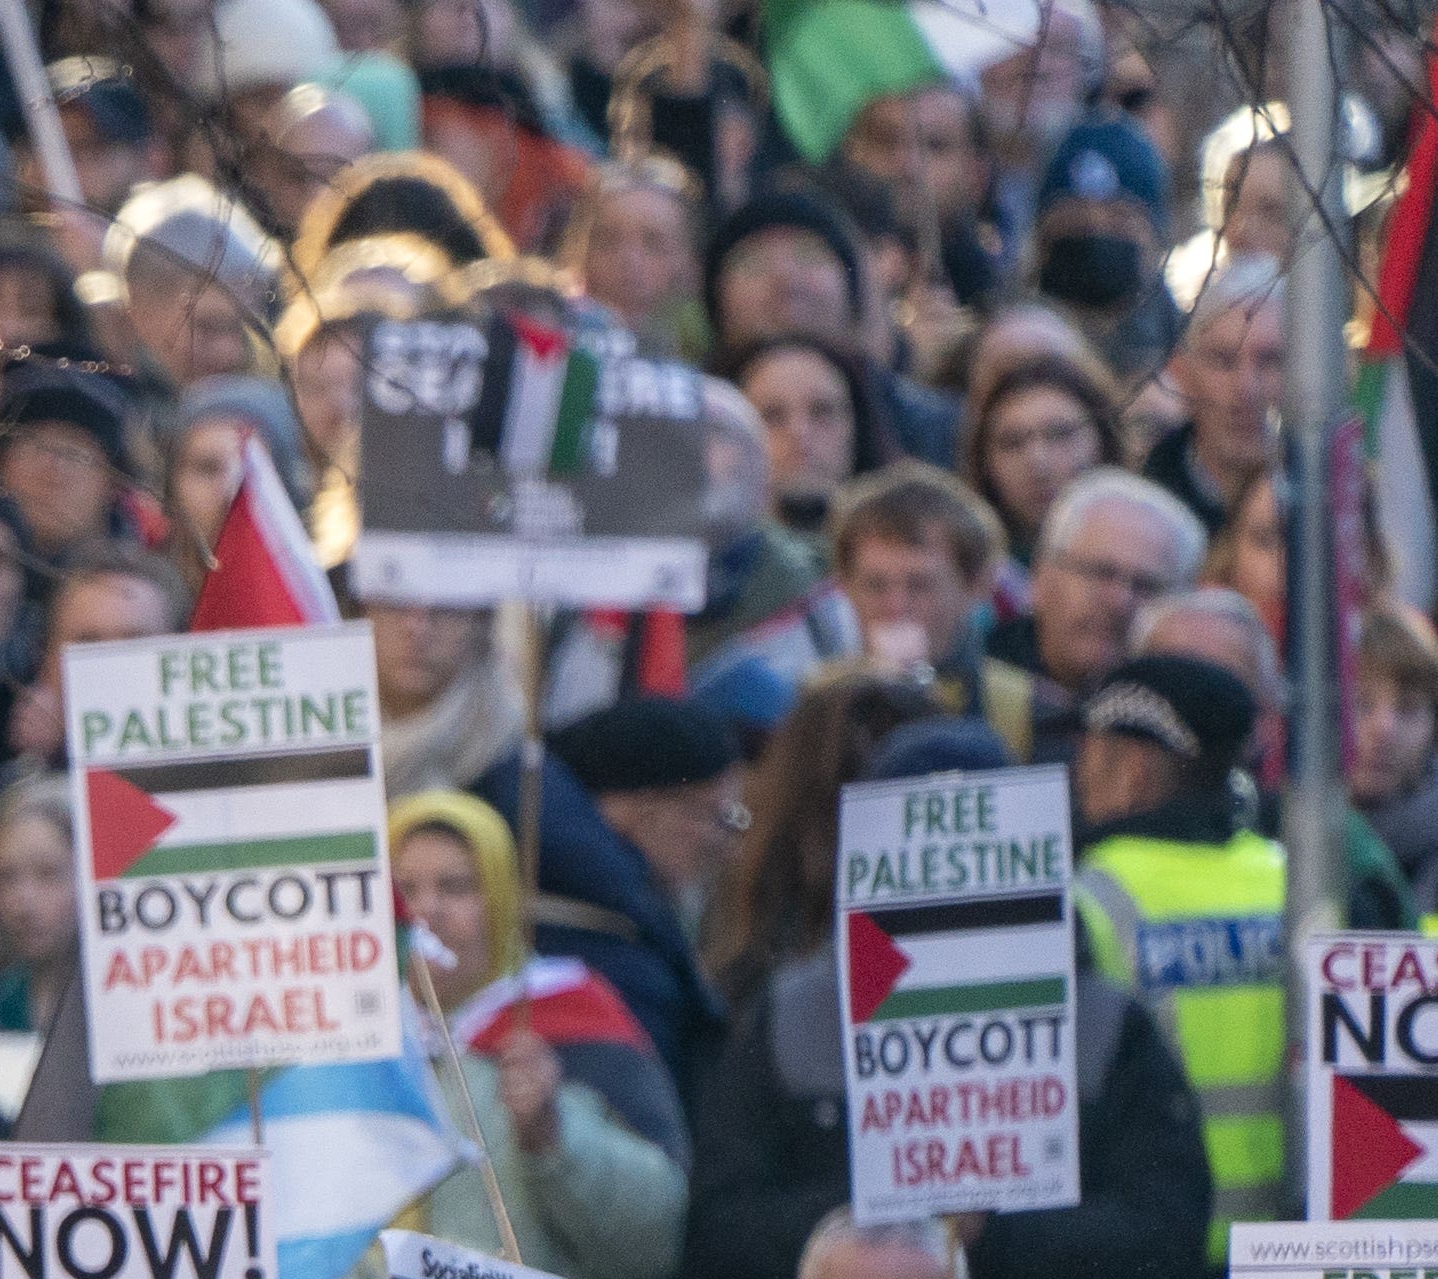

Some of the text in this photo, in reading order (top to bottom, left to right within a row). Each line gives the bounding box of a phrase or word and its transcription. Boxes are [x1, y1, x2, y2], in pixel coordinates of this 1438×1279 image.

[158, 643, 284, 696] FREE
[83, 690, 370, 750] PALESTINE
[903, 786, 998, 838] FREE
[846, 834, 1066, 900] PALESTINE
[96, 870, 378, 936] BOYCOTT
[102, 931, 382, 992] APARTHEID
[1144, 926, 1282, 984] POLIC
[151, 995, 339, 1046] ISRAEL
[854, 1017, 1065, 1080] BOYCOTT
[860, 1076, 1065, 1134] APARTHEID
[890, 1138, 1032, 1186] ISRAEL
